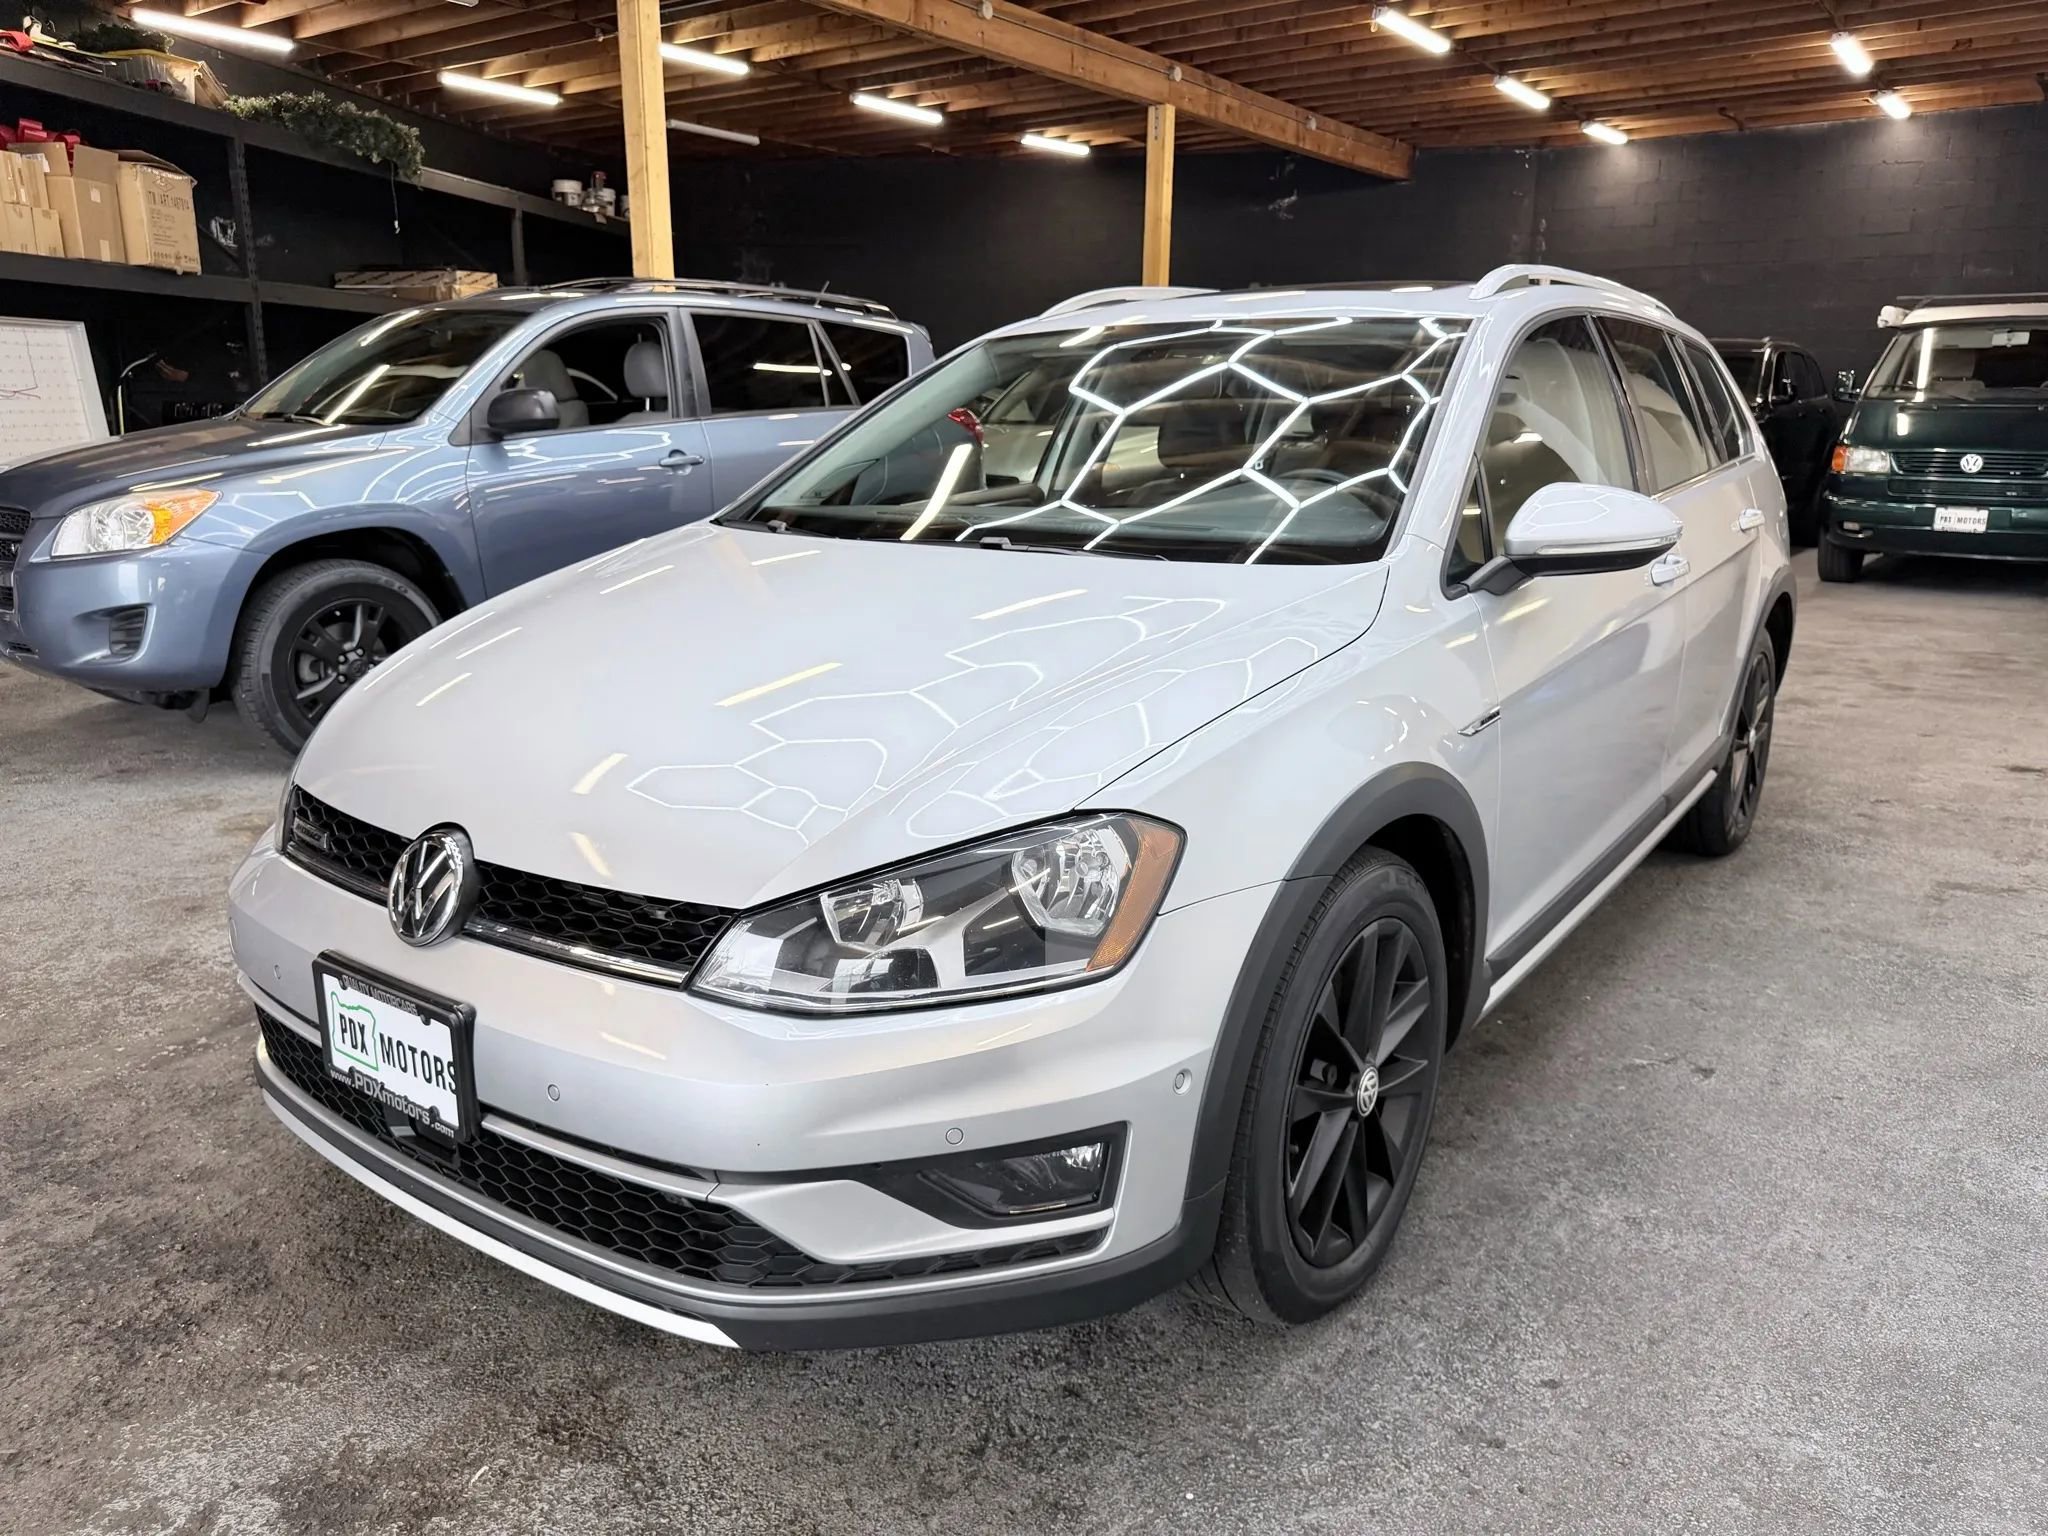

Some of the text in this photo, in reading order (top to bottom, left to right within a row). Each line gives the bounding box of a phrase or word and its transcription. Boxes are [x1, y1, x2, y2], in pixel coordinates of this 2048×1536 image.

[339, 1013, 457, 1095] PDX MOTORS
[330, 1069, 455, 1138] www.PDXmotors.com
